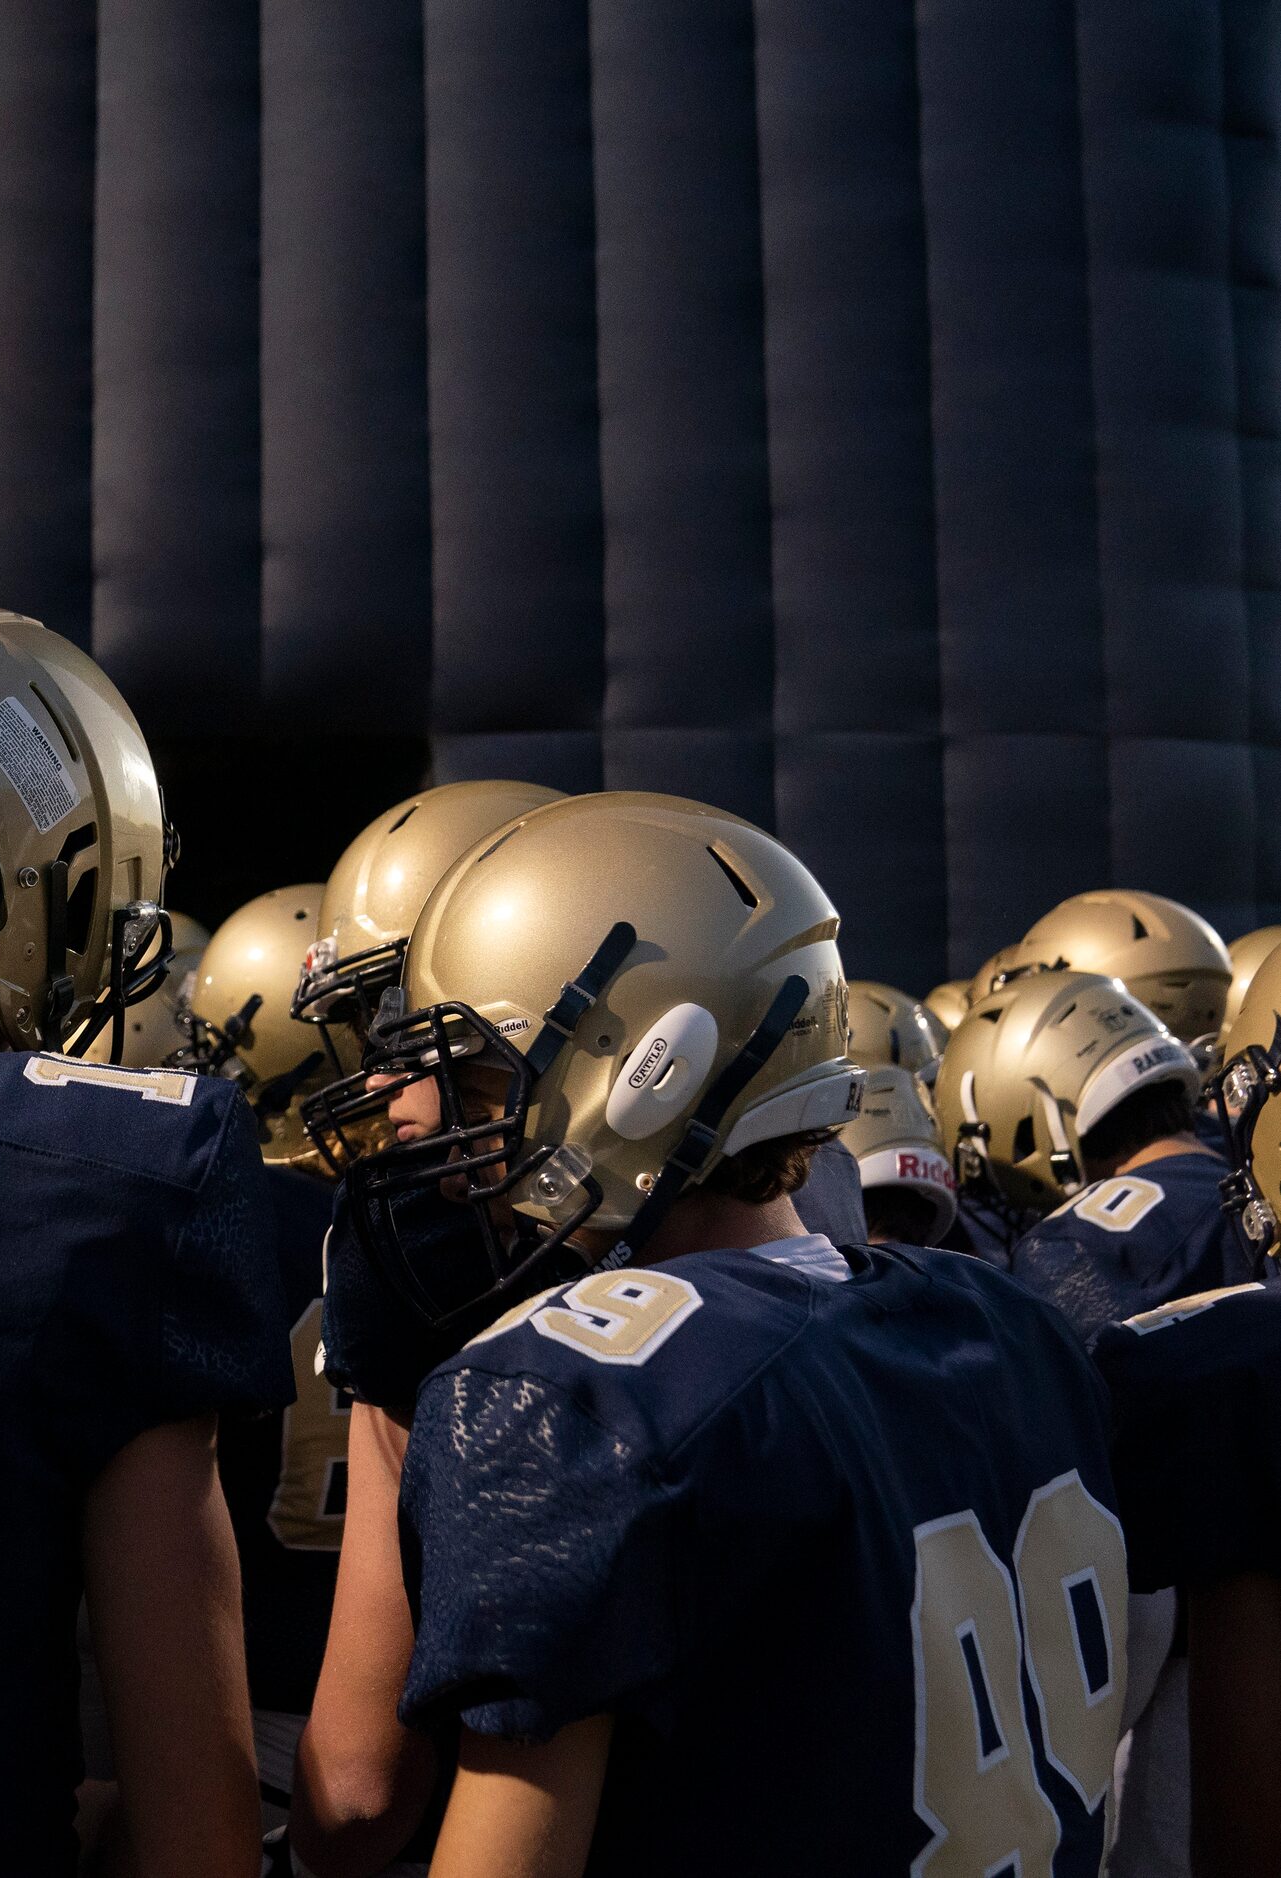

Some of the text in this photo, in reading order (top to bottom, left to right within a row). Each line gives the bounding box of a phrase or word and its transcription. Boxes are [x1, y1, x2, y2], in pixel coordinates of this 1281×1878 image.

[31, 726, 63, 771] WARNING
[632, 1042, 664, 1084] BATTLE
[909, 1468, 1130, 1878] 89
